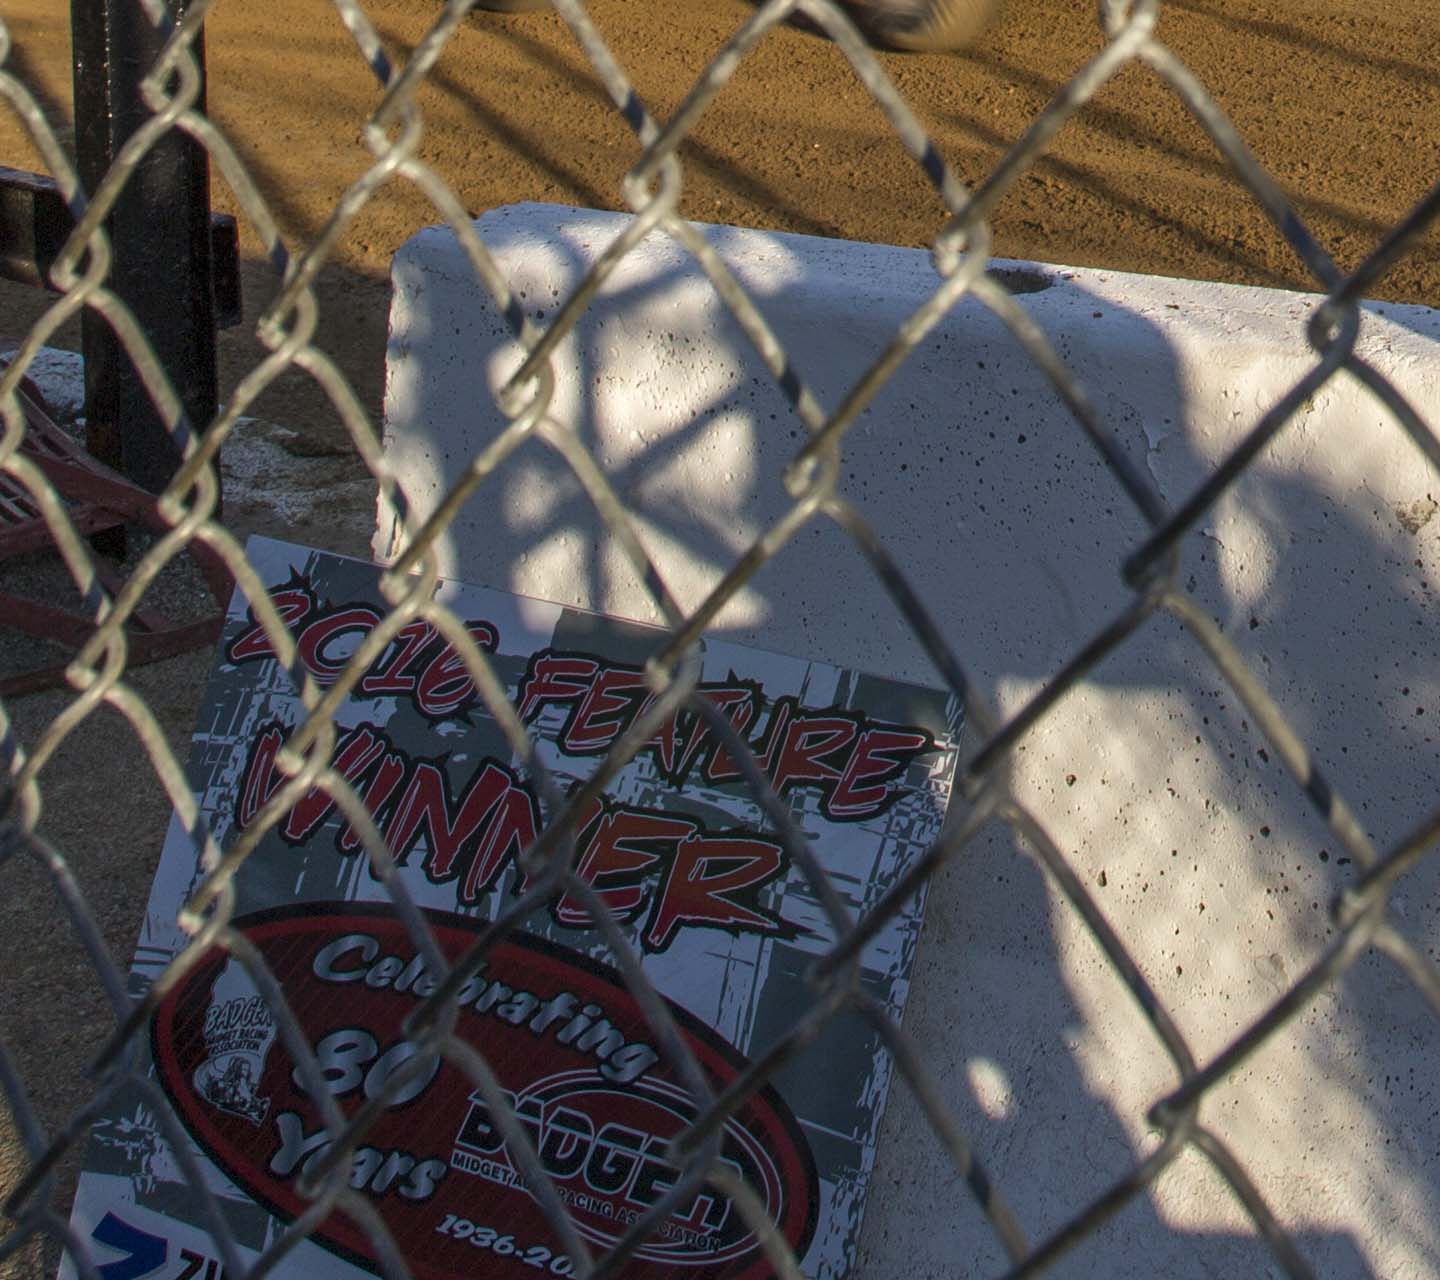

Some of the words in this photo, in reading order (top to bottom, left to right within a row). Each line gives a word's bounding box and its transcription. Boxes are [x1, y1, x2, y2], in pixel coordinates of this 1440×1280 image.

[229, 585, 500, 722] 2016
[516, 652, 939, 824] FEATURE
[236, 722, 812, 954] WINNER
[292, 1028, 443, 1112] 80
[312, 932, 660, 1083] Celebrating
[267, 1111, 451, 1203] Yars
[452, 1151, 512, 1182] MIDGET
[556, 1187, 613, 1218] RACING
